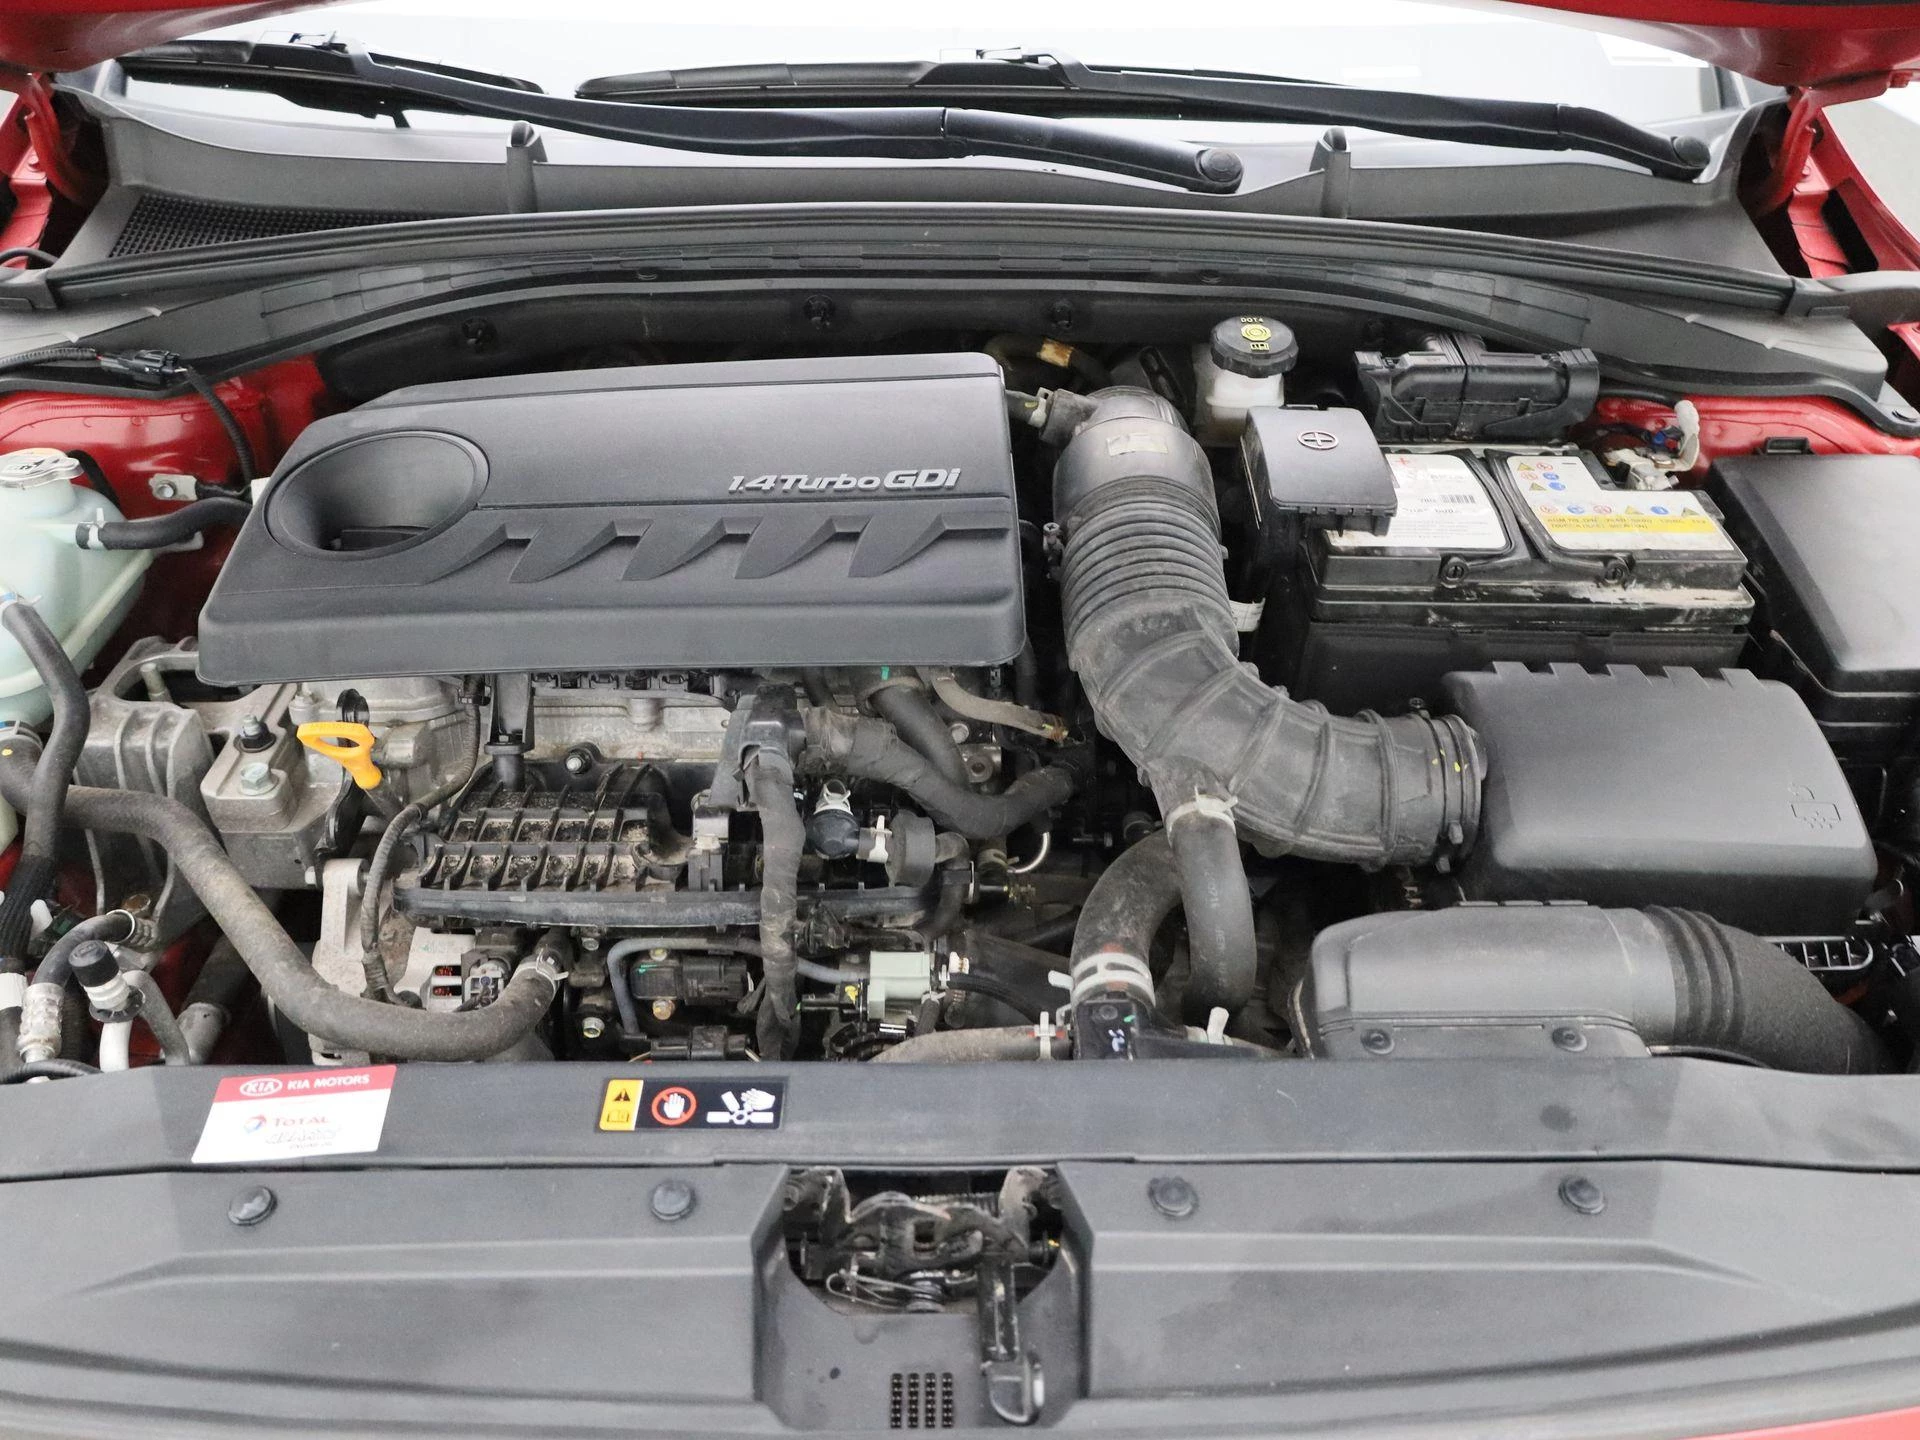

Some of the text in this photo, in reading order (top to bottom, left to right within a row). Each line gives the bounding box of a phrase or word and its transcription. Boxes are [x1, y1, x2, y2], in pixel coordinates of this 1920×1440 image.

[728, 475, 776, 492] 1.4
[779, 473, 881, 493] Turbo
[245, 1079, 277, 1094] KIA
[287, 1074, 370, 1091] KIA MOTORS
